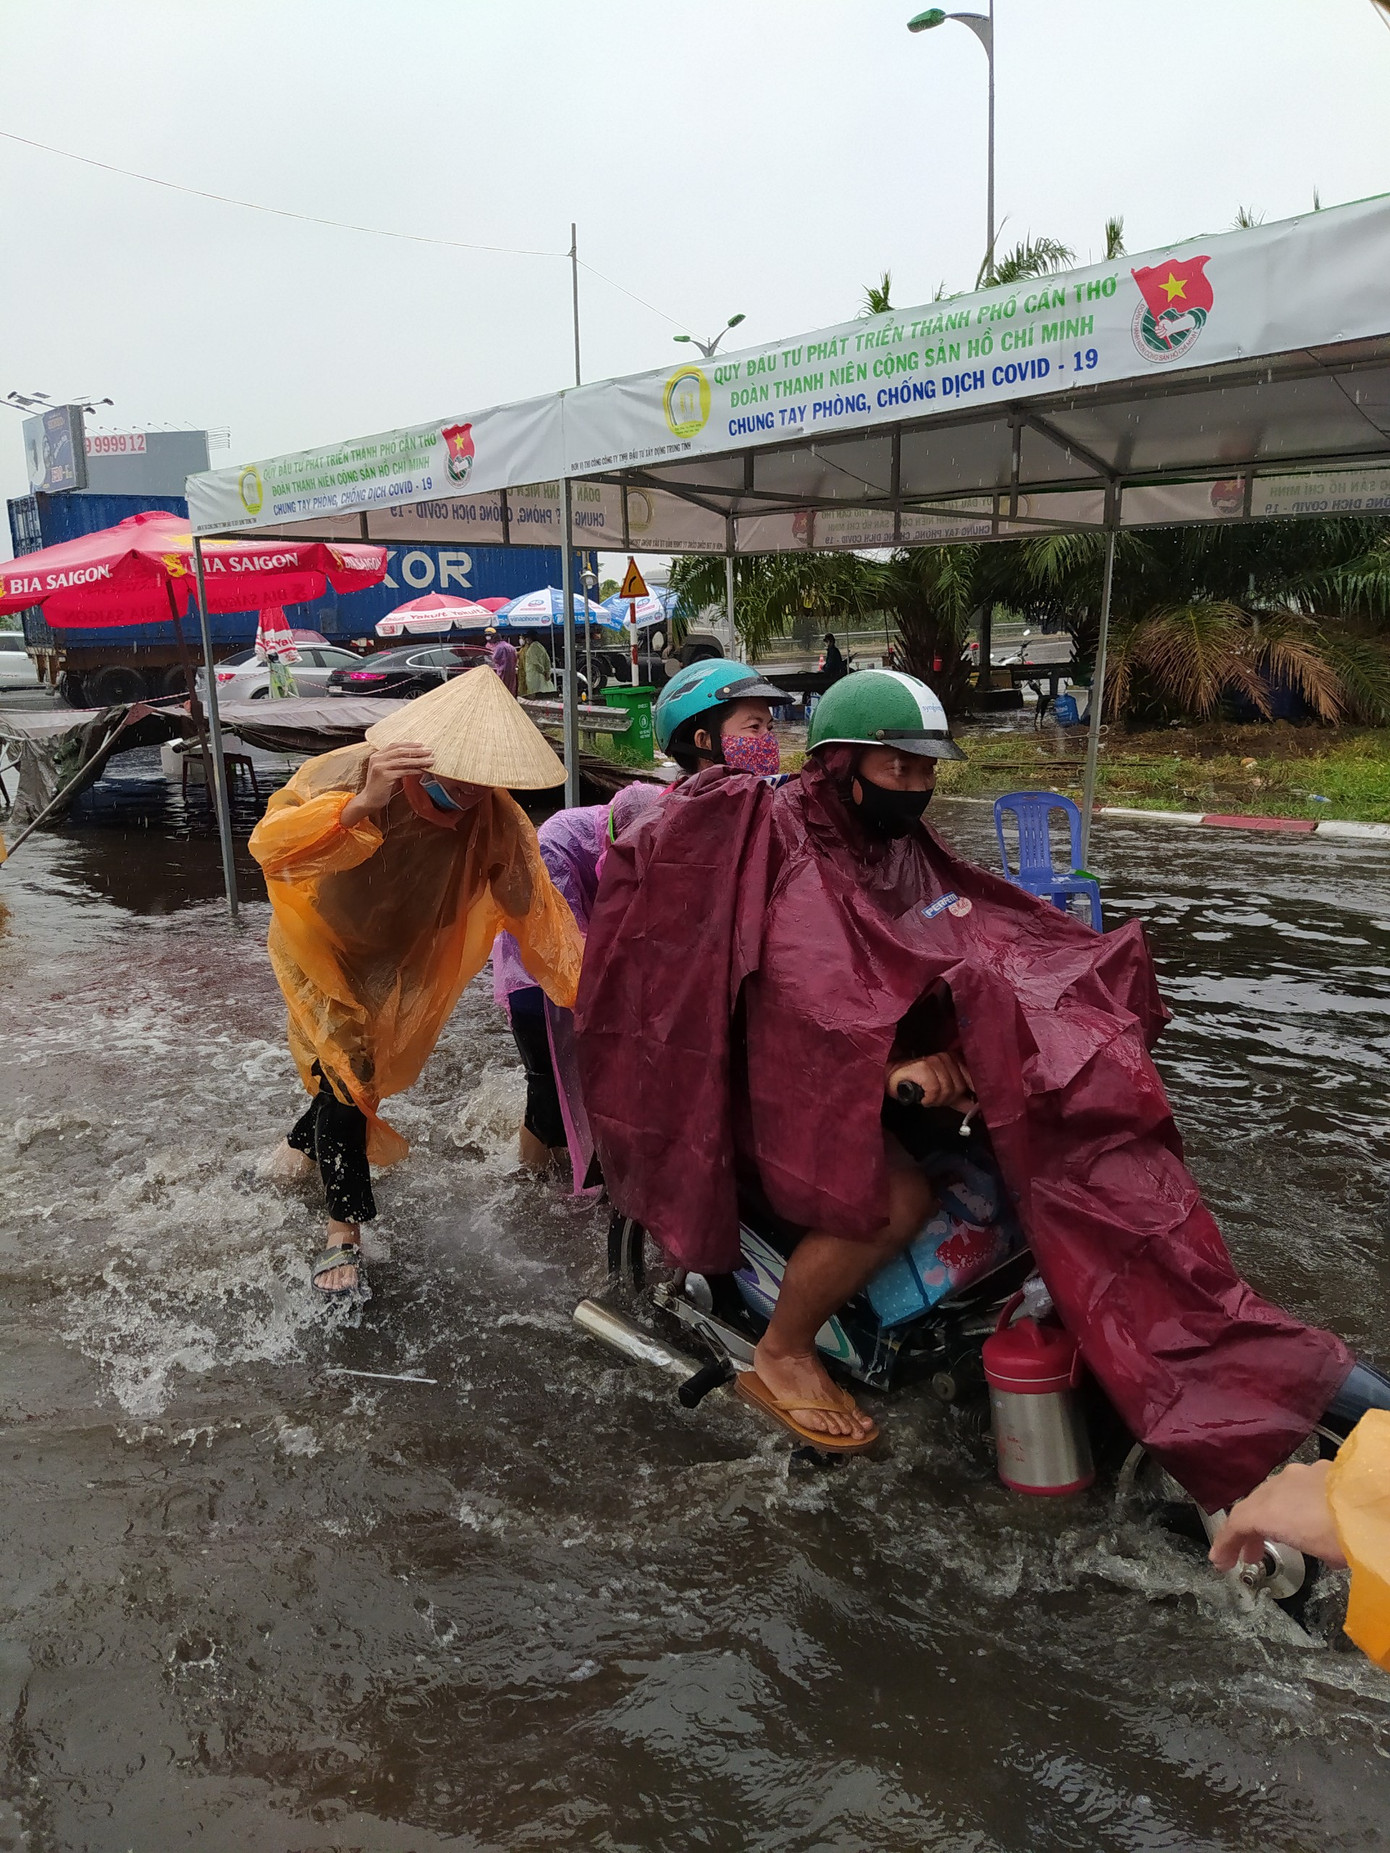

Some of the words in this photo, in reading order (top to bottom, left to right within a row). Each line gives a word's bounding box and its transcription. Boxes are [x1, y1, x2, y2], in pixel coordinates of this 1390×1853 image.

[782, 345, 803, 368] TƯ
[807, 335, 849, 363] PHÁT
[855, 317, 905, 352] TRIỂN
[911, 312, 971, 339] THÀNH
[977, 290, 1021, 324] PHỐ
[1023, 283, 1066, 314] CẦN
[1073, 272, 1119, 303] THƠ
[730, 382, 769, 408] ĐOÀN
[773, 372, 824, 399] THANH
[829, 360, 868, 387] NIÊN
[873, 352, 919, 379] CỘNG
[924, 338, 961, 368] SẢN
[967, 326, 994, 359] HỒ
[1001, 321, 1035, 352] CHÍ
[1041, 314, 1094, 344] MINH
[728, 411, 775, 437] CHUNG
[779, 405, 807, 426] TAY
[813, 393, 871, 420] PHÒNG,
[876, 376, 936, 408] CHỐNG
[942, 369, 985, 398] DỊCH
[992, 357, 1050, 387] COVID
[1073, 348, 1098, 372] 19
[94, 436, 127, 453] 9999
[129, 434, 145, 452] 12
[292, 477, 316, 493] THANH
[337, 469, 359, 487] CỘNG
[408, 455, 430, 472] MINH
[273, 502, 297, 516] CHUNG
[298, 498, 311, 511] TAY
[341, 486, 366, 503] CHỐNG
[368, 485, 386, 502] DỊCH
[388, 480, 413, 496] COVID
[422, 477, 433, 491] 19
[10, 576, 43, 595] BIA
[46, 564, 110, 590] SAIGON
[229, 553, 298, 572] SAIGON
[410, 611, 448, 620] Yakult
